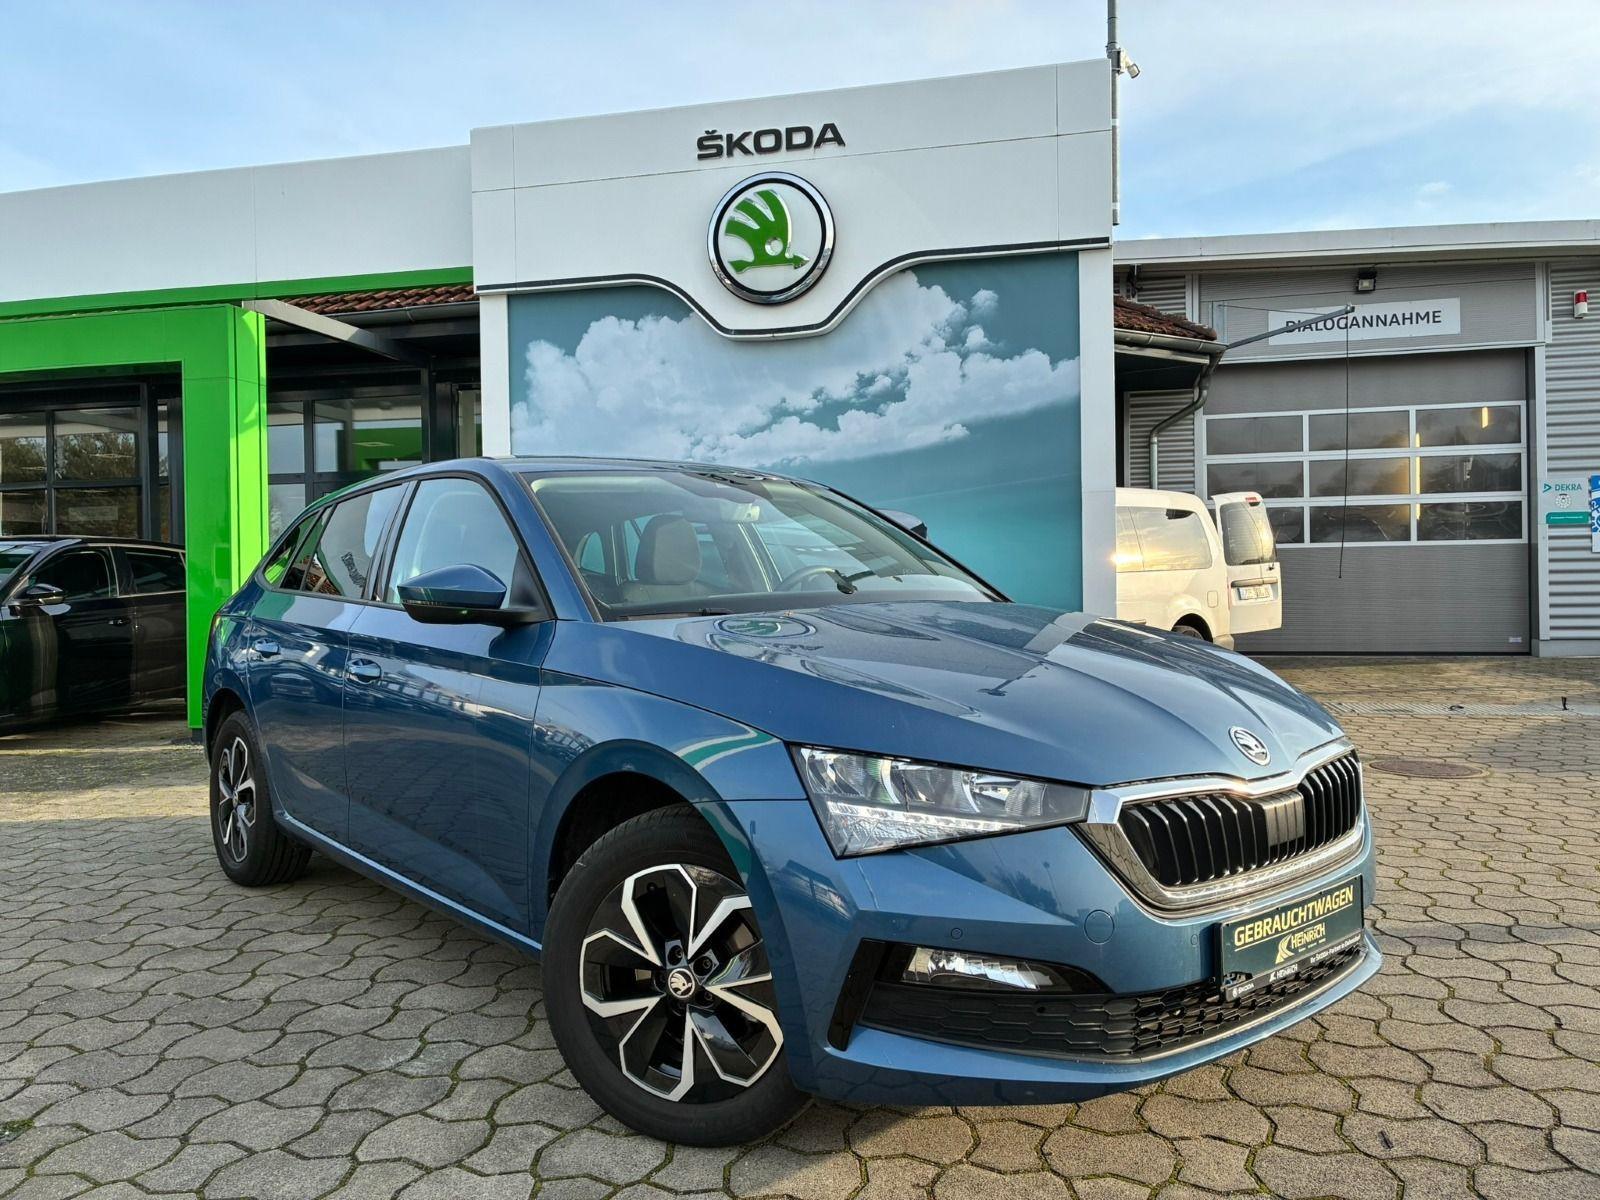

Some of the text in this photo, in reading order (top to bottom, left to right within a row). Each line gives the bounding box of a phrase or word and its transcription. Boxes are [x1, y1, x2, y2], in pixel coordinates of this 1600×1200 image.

[697, 122, 846, 160] ŠKODA
[1555, 483, 1583, 491] DEKRA
[1234, 885, 1354, 946] GEBRAUCHTWAGEN
